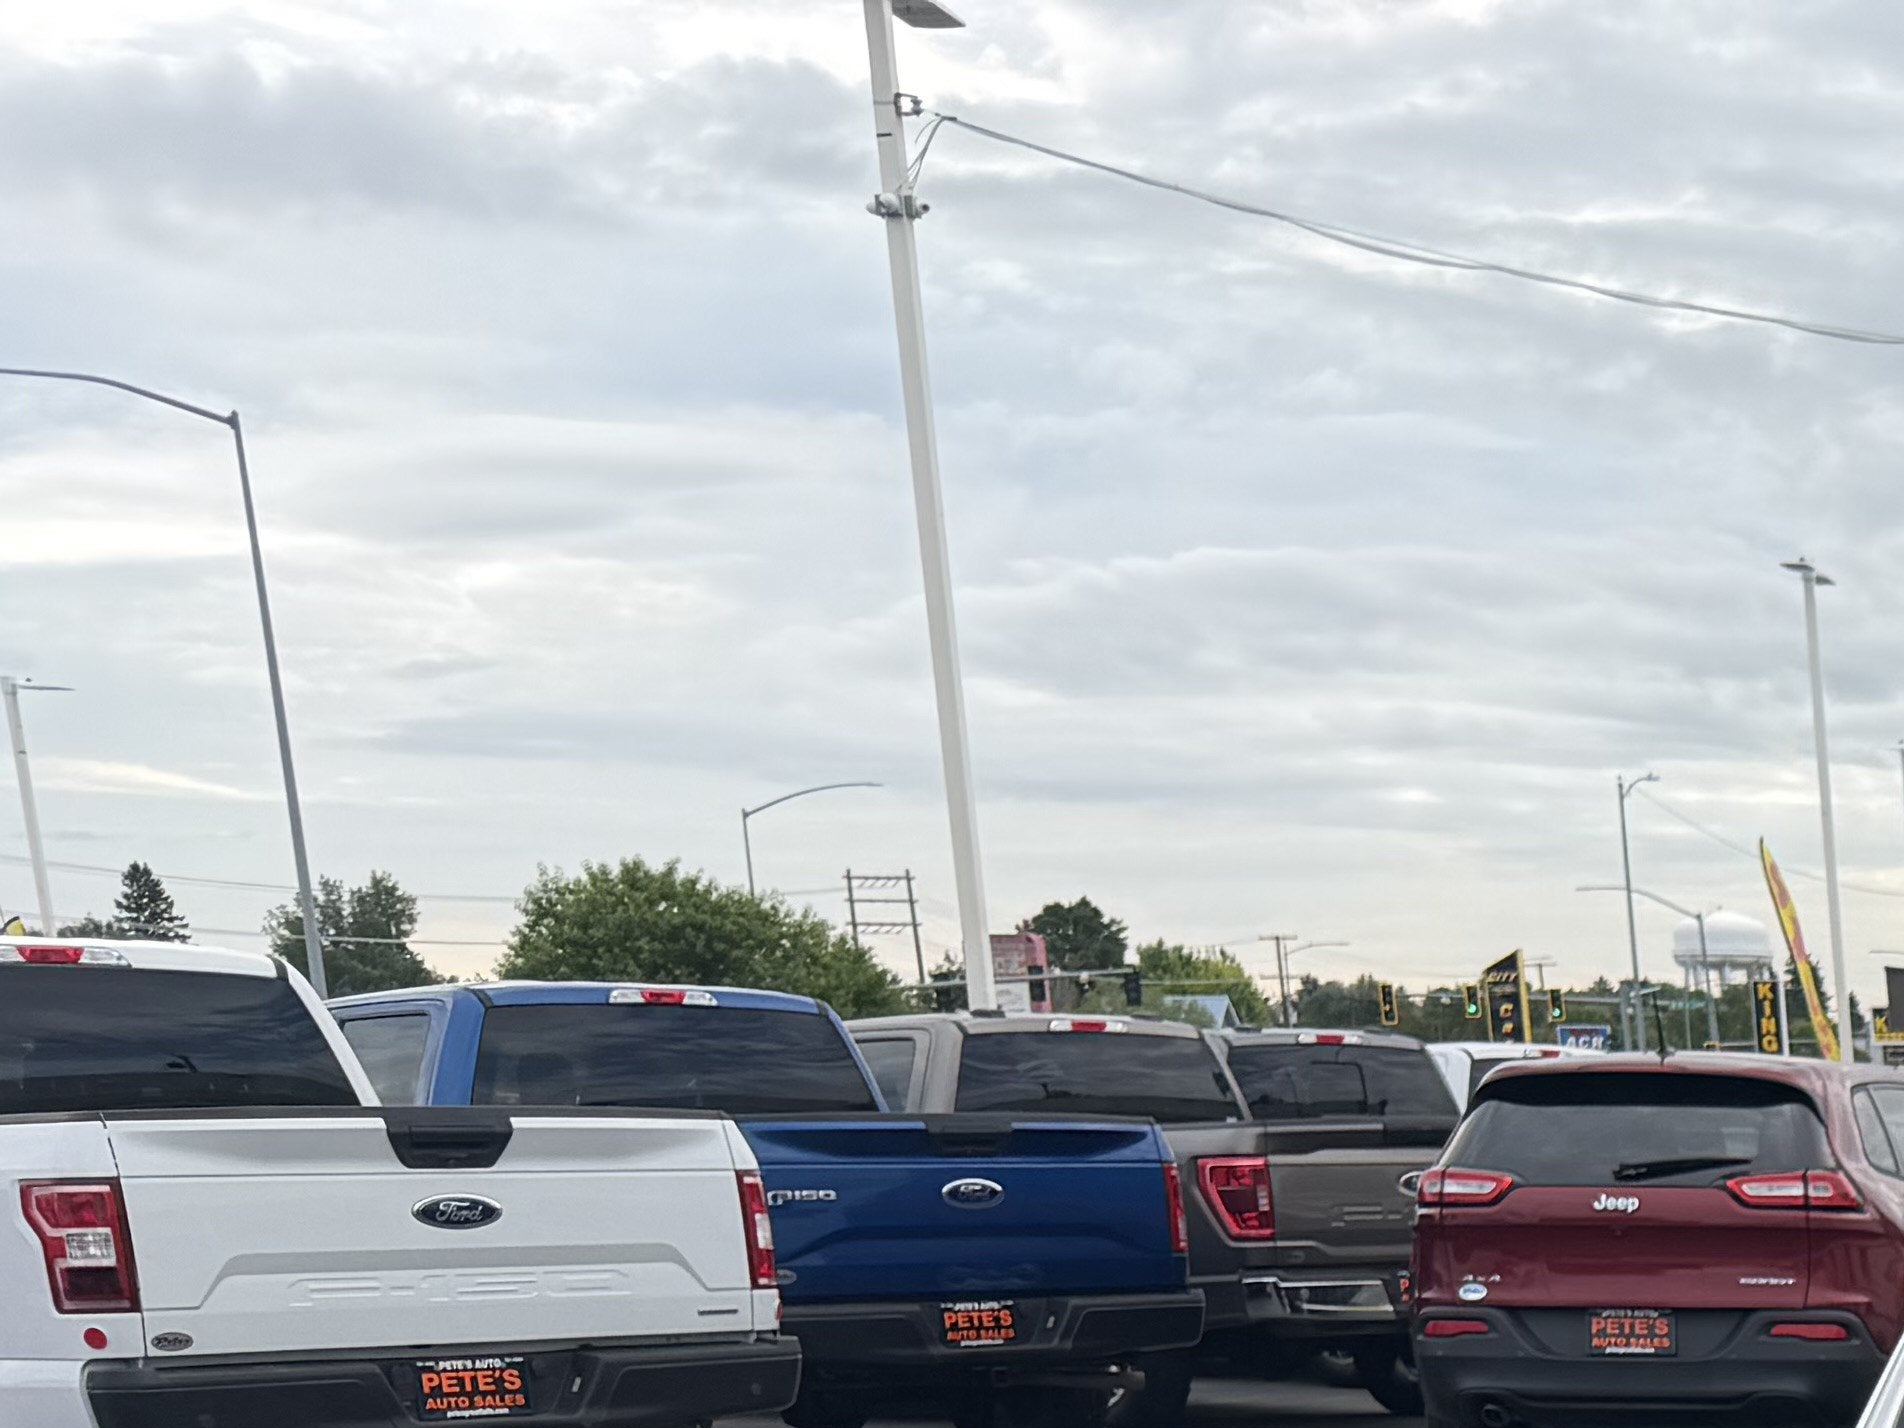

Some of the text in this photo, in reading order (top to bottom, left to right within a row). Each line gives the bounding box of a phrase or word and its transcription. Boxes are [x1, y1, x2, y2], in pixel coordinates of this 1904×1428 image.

[436, 1201, 484, 1223] Ford
[1593, 1194, 1640, 1213] Jeep
[944, 1310, 1013, 1329] PETE'S
[1591, 1317, 1669, 1335] PETE'S
[421, 1368, 522, 1394] PETE'S
[425, 1394, 525, 1410] AUTO SALES
